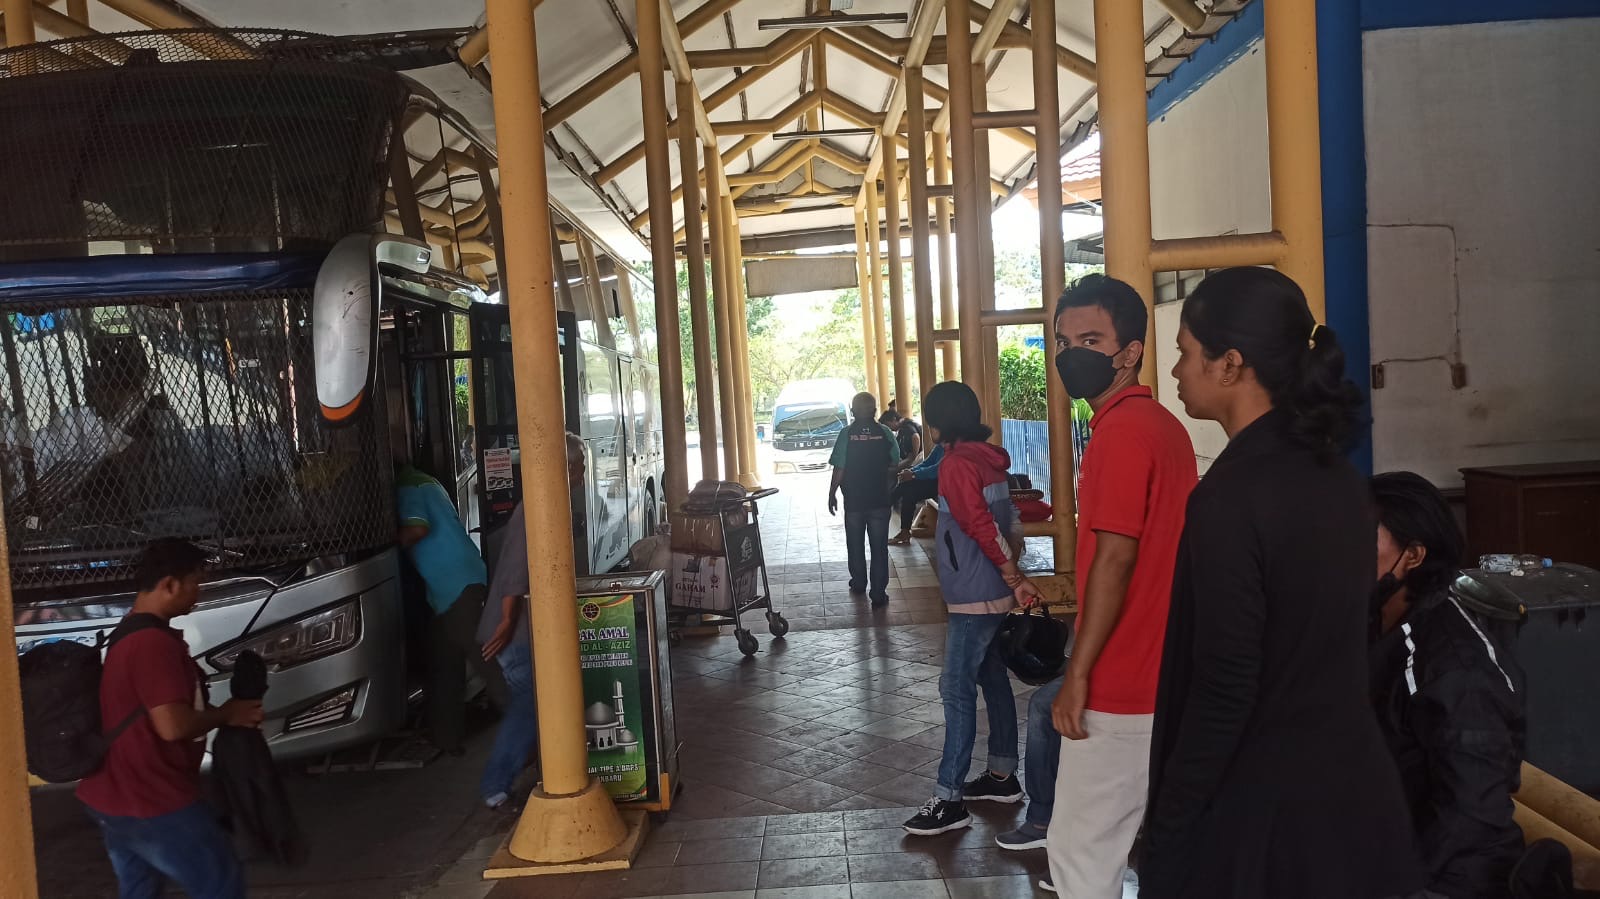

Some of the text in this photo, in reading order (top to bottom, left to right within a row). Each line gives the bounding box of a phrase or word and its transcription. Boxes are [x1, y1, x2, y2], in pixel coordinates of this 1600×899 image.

[794, 440, 828, 448] ISUZU
[579, 627, 629, 641] AK AMAL
[592, 642, 603, 651] AL
[611, 640, 631, 650] AZIZ
